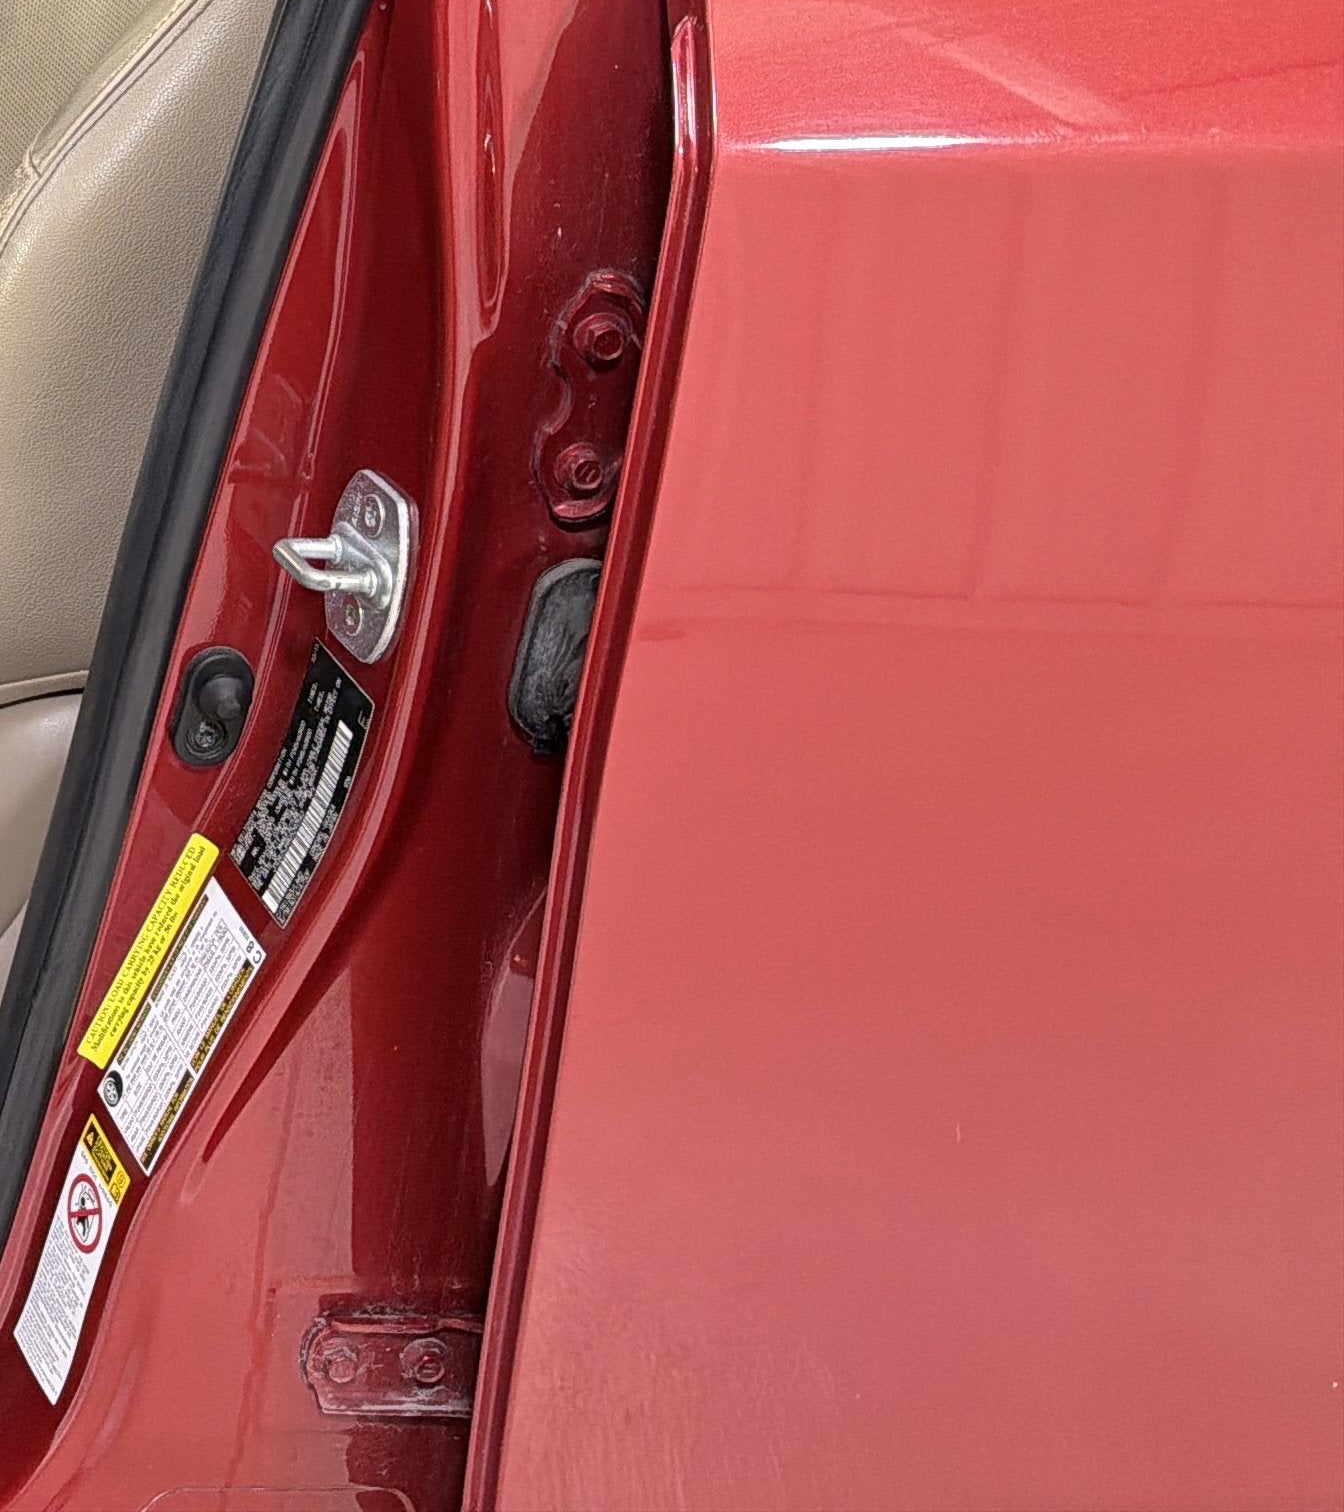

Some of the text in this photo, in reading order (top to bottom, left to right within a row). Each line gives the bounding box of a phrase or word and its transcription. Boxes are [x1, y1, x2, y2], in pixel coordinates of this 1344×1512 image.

[90, 1002, 120, 1052] Modifications
[121, 979, 133, 995] this
[129, 953, 147, 980] vehicle
[143, 935, 157, 954] have
[153, 905, 173, 936] reduced
[169, 891, 180, 906] the
[176, 862, 197, 894] original
[192, 844, 206, 863] load
[107, 977, 125, 1003] LOAD
[121, 932, 149, 979] CARRYING
[145, 888, 172, 933] CAPACITY
[169, 844, 196, 888] REDUCED
[108, 1005, 129, 1038] carrying
[124, 975, 145, 1008] capacity
